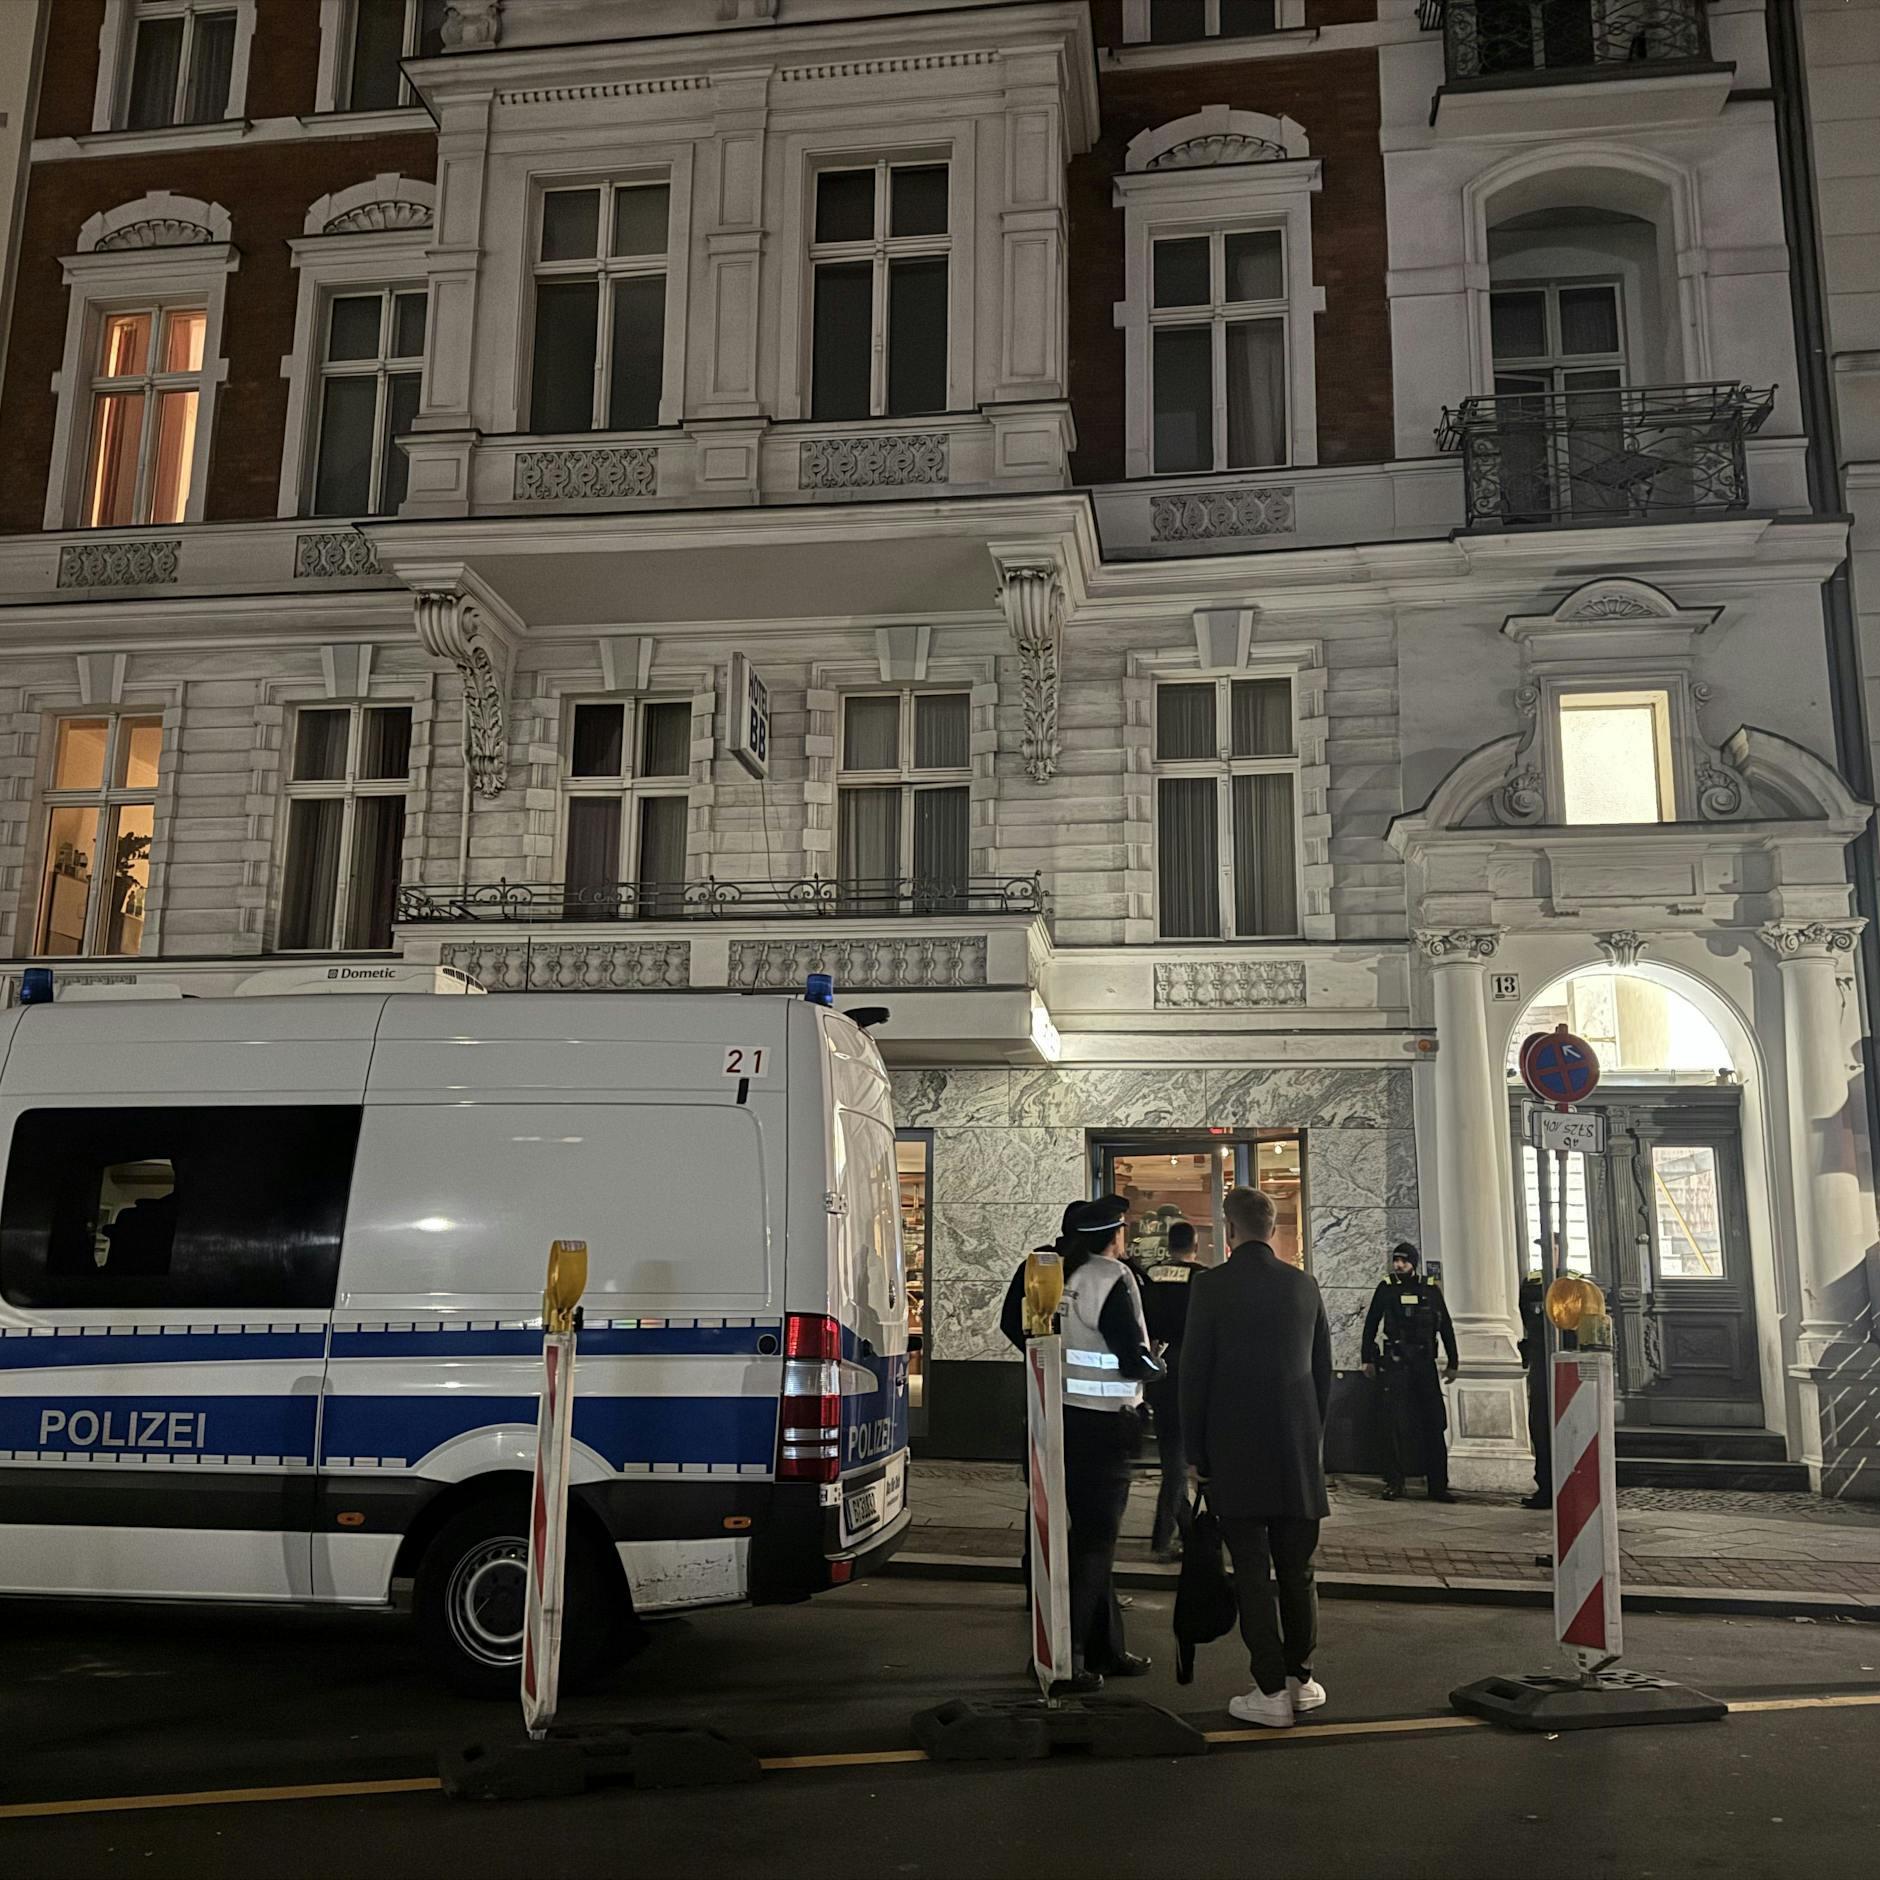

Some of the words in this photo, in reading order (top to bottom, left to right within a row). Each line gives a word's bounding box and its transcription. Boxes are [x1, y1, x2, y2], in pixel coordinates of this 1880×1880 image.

[748, 665, 768, 722] HOTEL
[341, 967, 397, 979] Dometic
[1495, 976, 1516, 993] 13
[726, 1049, 762, 1074] 21
[39, 1409, 206, 1449] POLIZEI
[848, 1417, 891, 1462] POLIZEI
